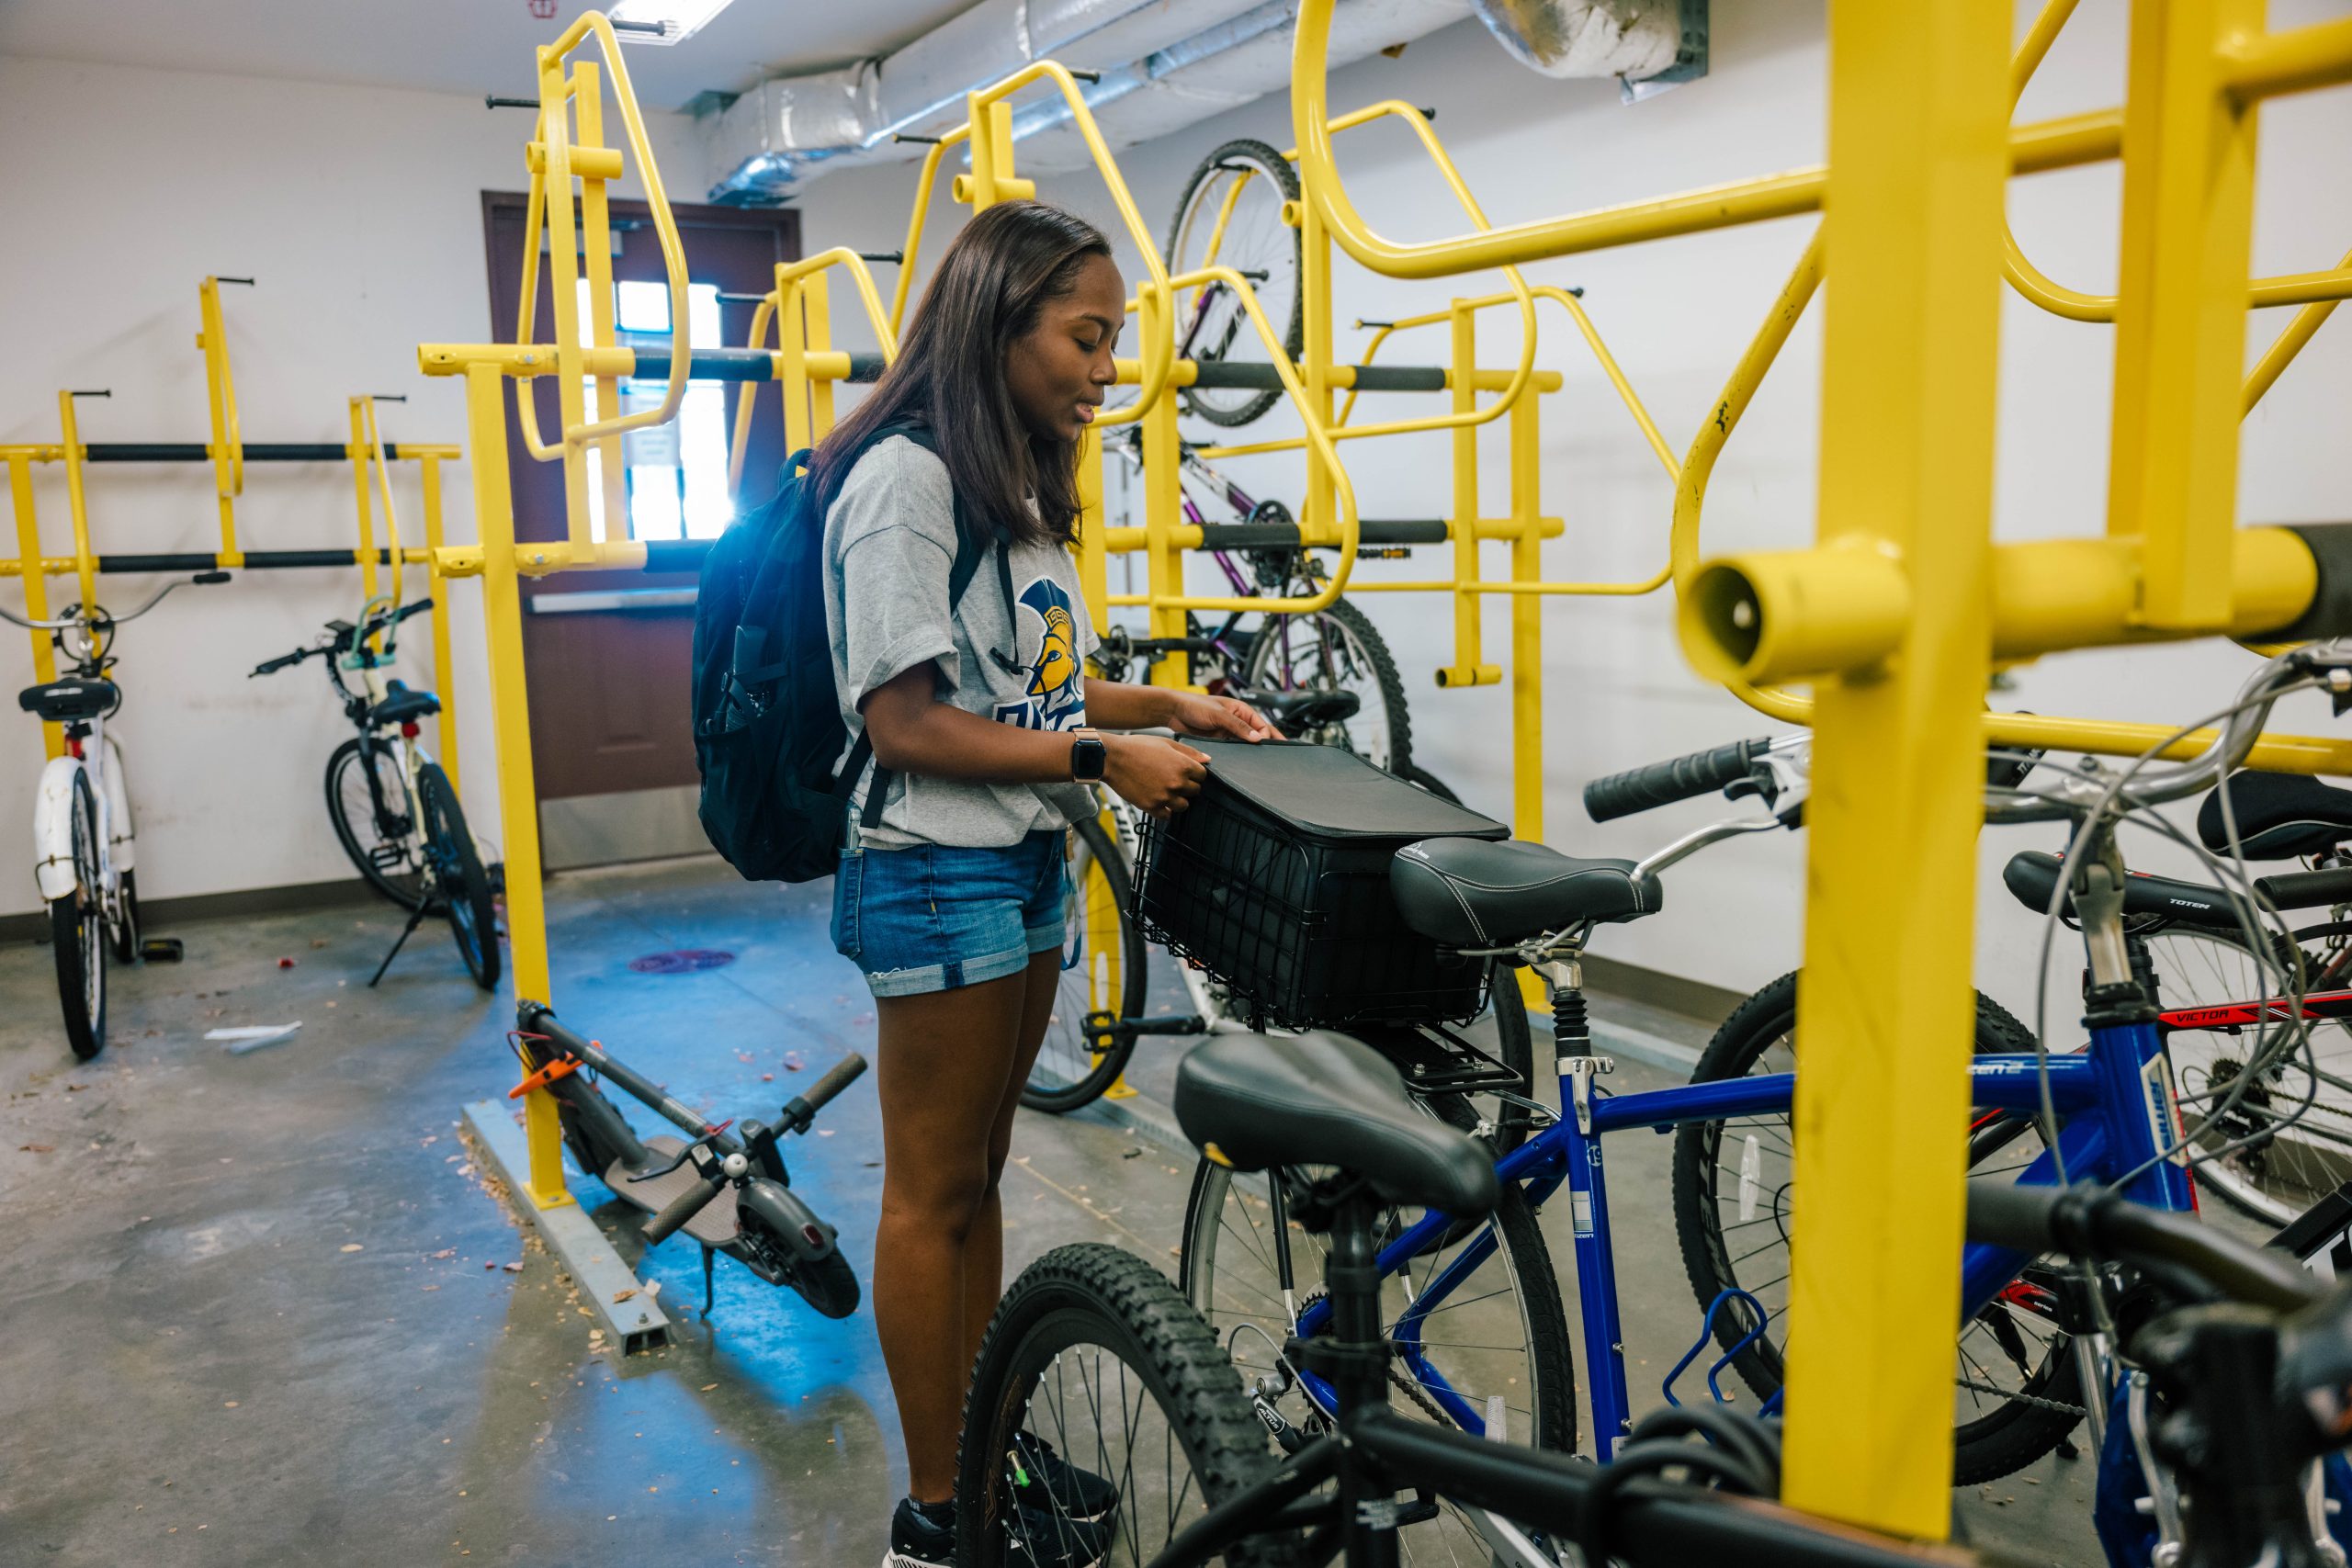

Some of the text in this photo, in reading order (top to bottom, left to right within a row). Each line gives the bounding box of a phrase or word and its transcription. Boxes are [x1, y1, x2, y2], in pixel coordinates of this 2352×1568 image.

[2170, 898, 2211, 909] TOTEM
[2177, 1010, 2229, 1022] VICTOR
[2033, 1301, 2052, 1313] series
[1258, 1407, 1279, 1429] ALTUS
